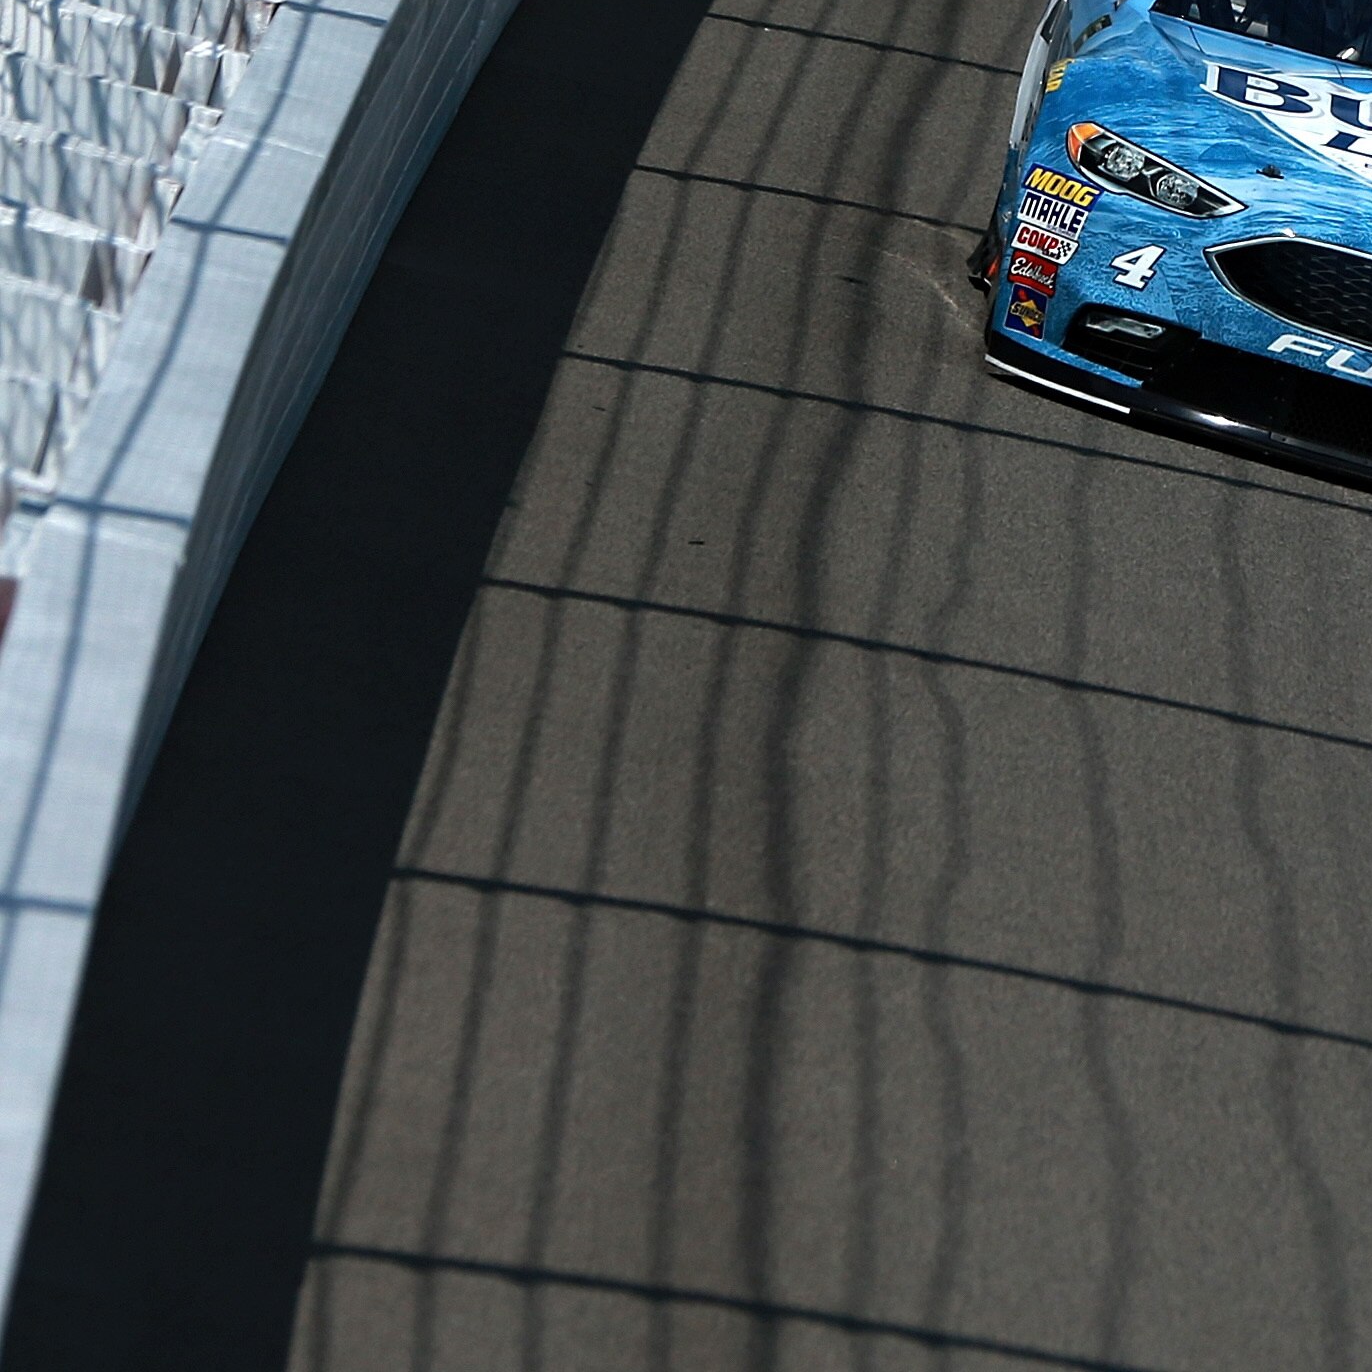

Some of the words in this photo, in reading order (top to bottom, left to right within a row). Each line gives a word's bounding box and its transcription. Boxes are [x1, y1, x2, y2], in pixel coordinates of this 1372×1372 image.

[1025, 167, 1100, 207] MOOG
[1020, 195, 1085, 234] MAHLE
[1110, 243, 1167, 291] 4
